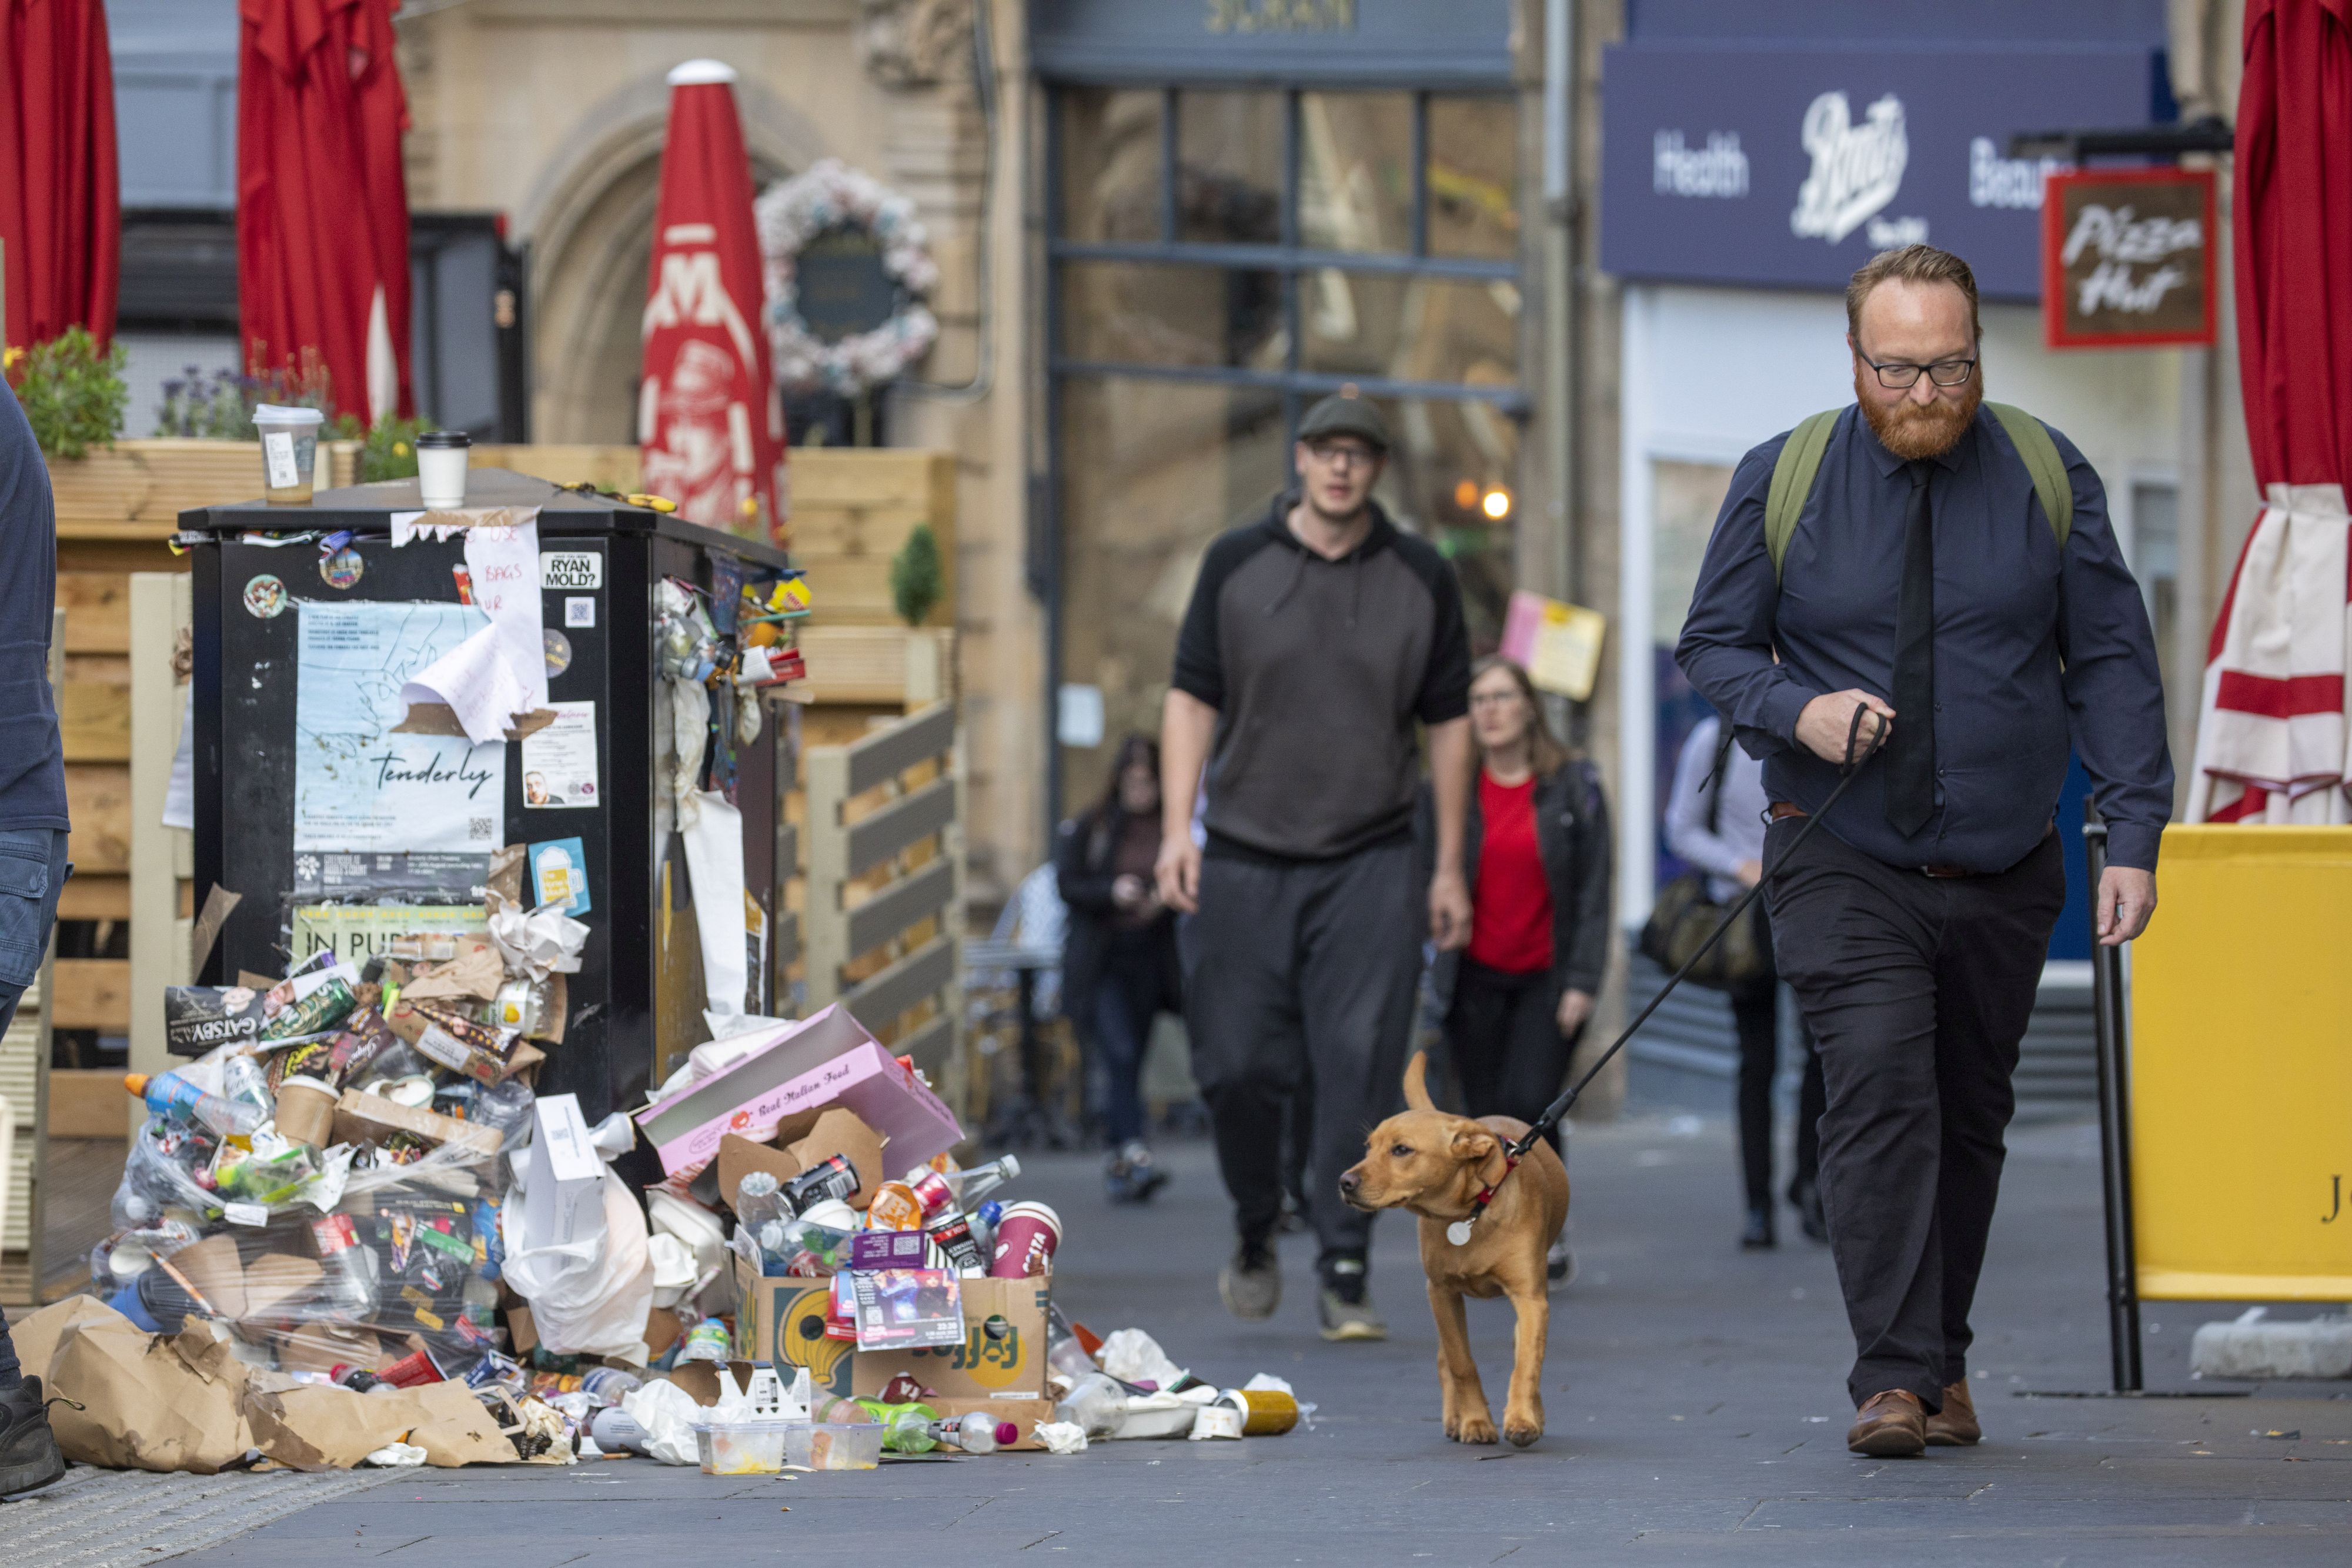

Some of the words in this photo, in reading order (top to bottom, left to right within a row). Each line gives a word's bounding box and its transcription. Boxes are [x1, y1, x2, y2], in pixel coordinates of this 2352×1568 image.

[1653, 128, 1750, 198] Health
[2062, 203, 2203, 266] Pizza
[2079, 260, 2184, 316] Hut
[485, 563, 522, 583] BAGS
[546, 574, 596, 586] MOLD?
[552, 560, 590, 572] RYAN
[370, 747, 493, 800] Tenderly
[307, 932, 336, 957] IN
[192, 1017, 257, 1042] GATSBY
[759, 1100, 781, 1118] Real
[784, 1081, 821, 1105] Italian
[823, 1064, 850, 1086] Food
